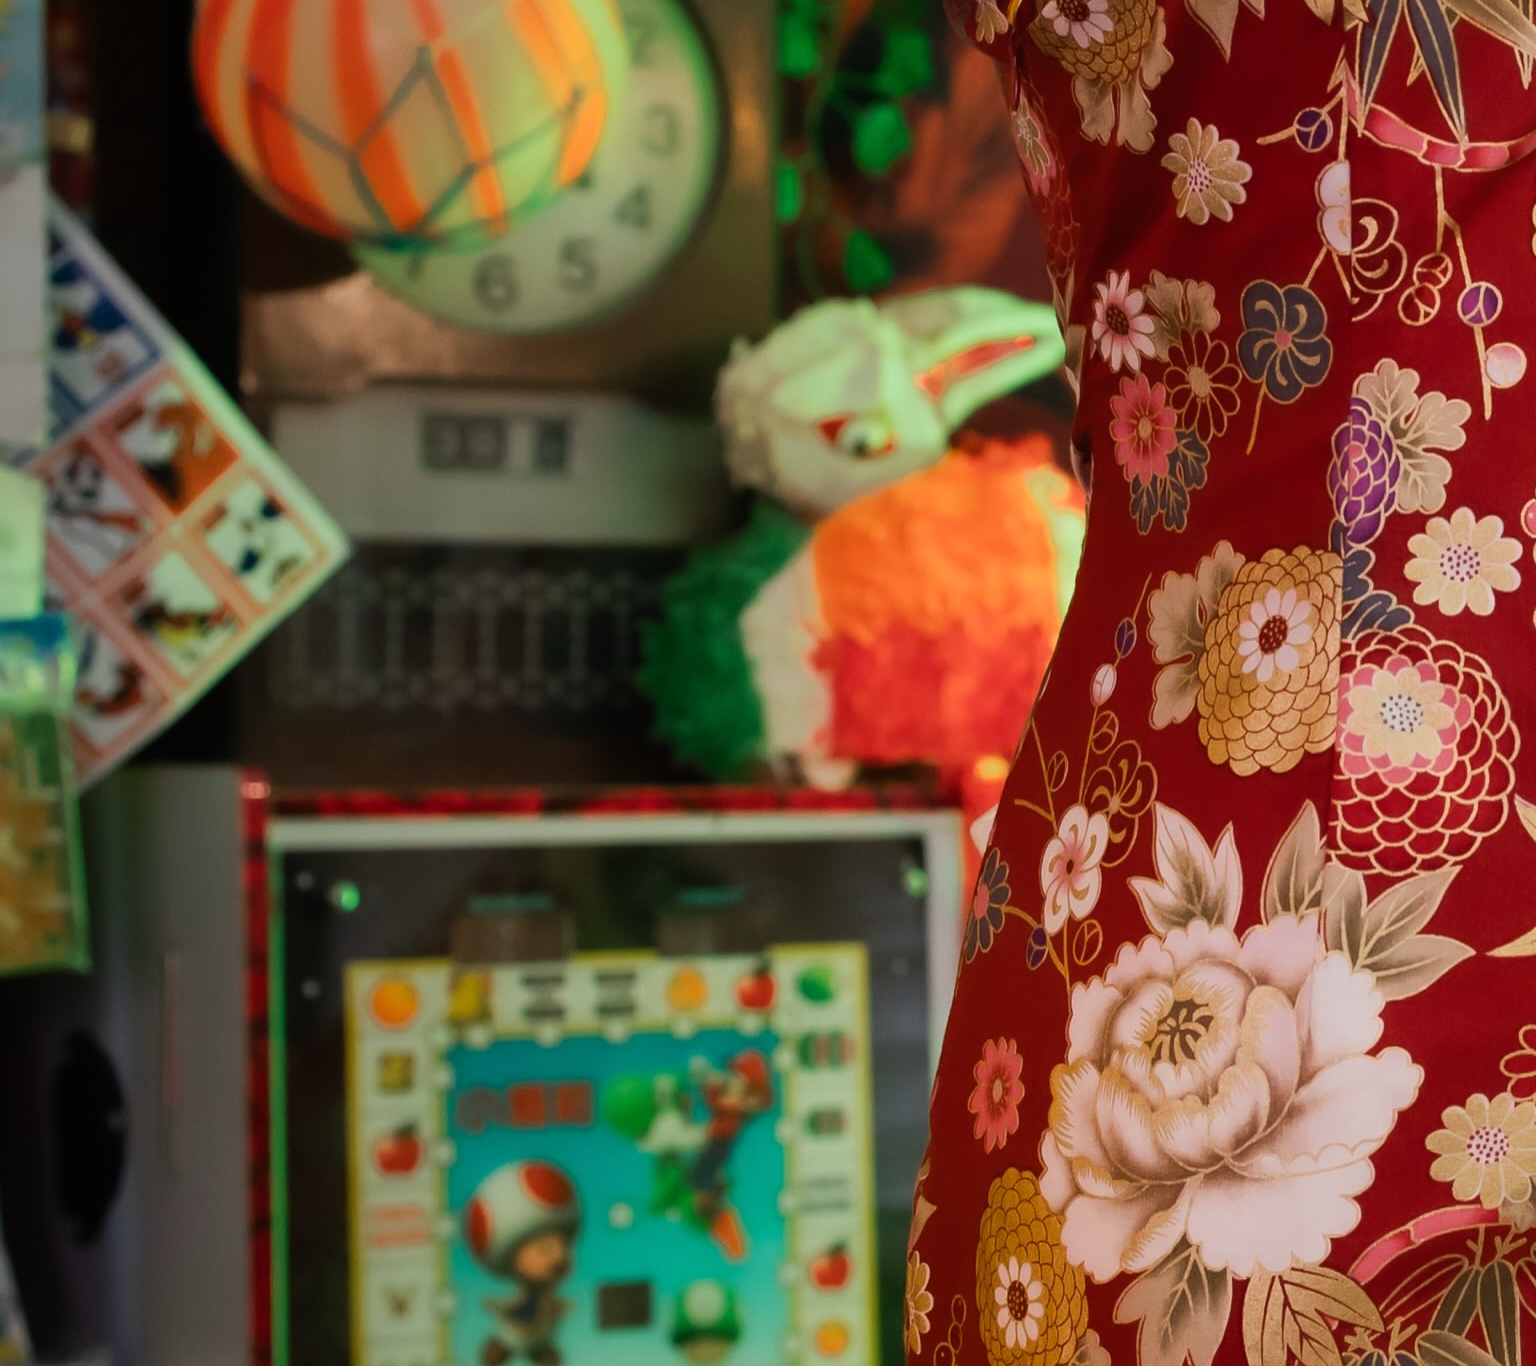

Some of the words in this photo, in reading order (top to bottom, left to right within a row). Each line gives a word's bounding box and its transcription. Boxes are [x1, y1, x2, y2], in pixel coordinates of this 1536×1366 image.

[612, 184, 652, 232] 4
[471, 251, 520, 314] 6
[555, 235, 600, 295] 5
